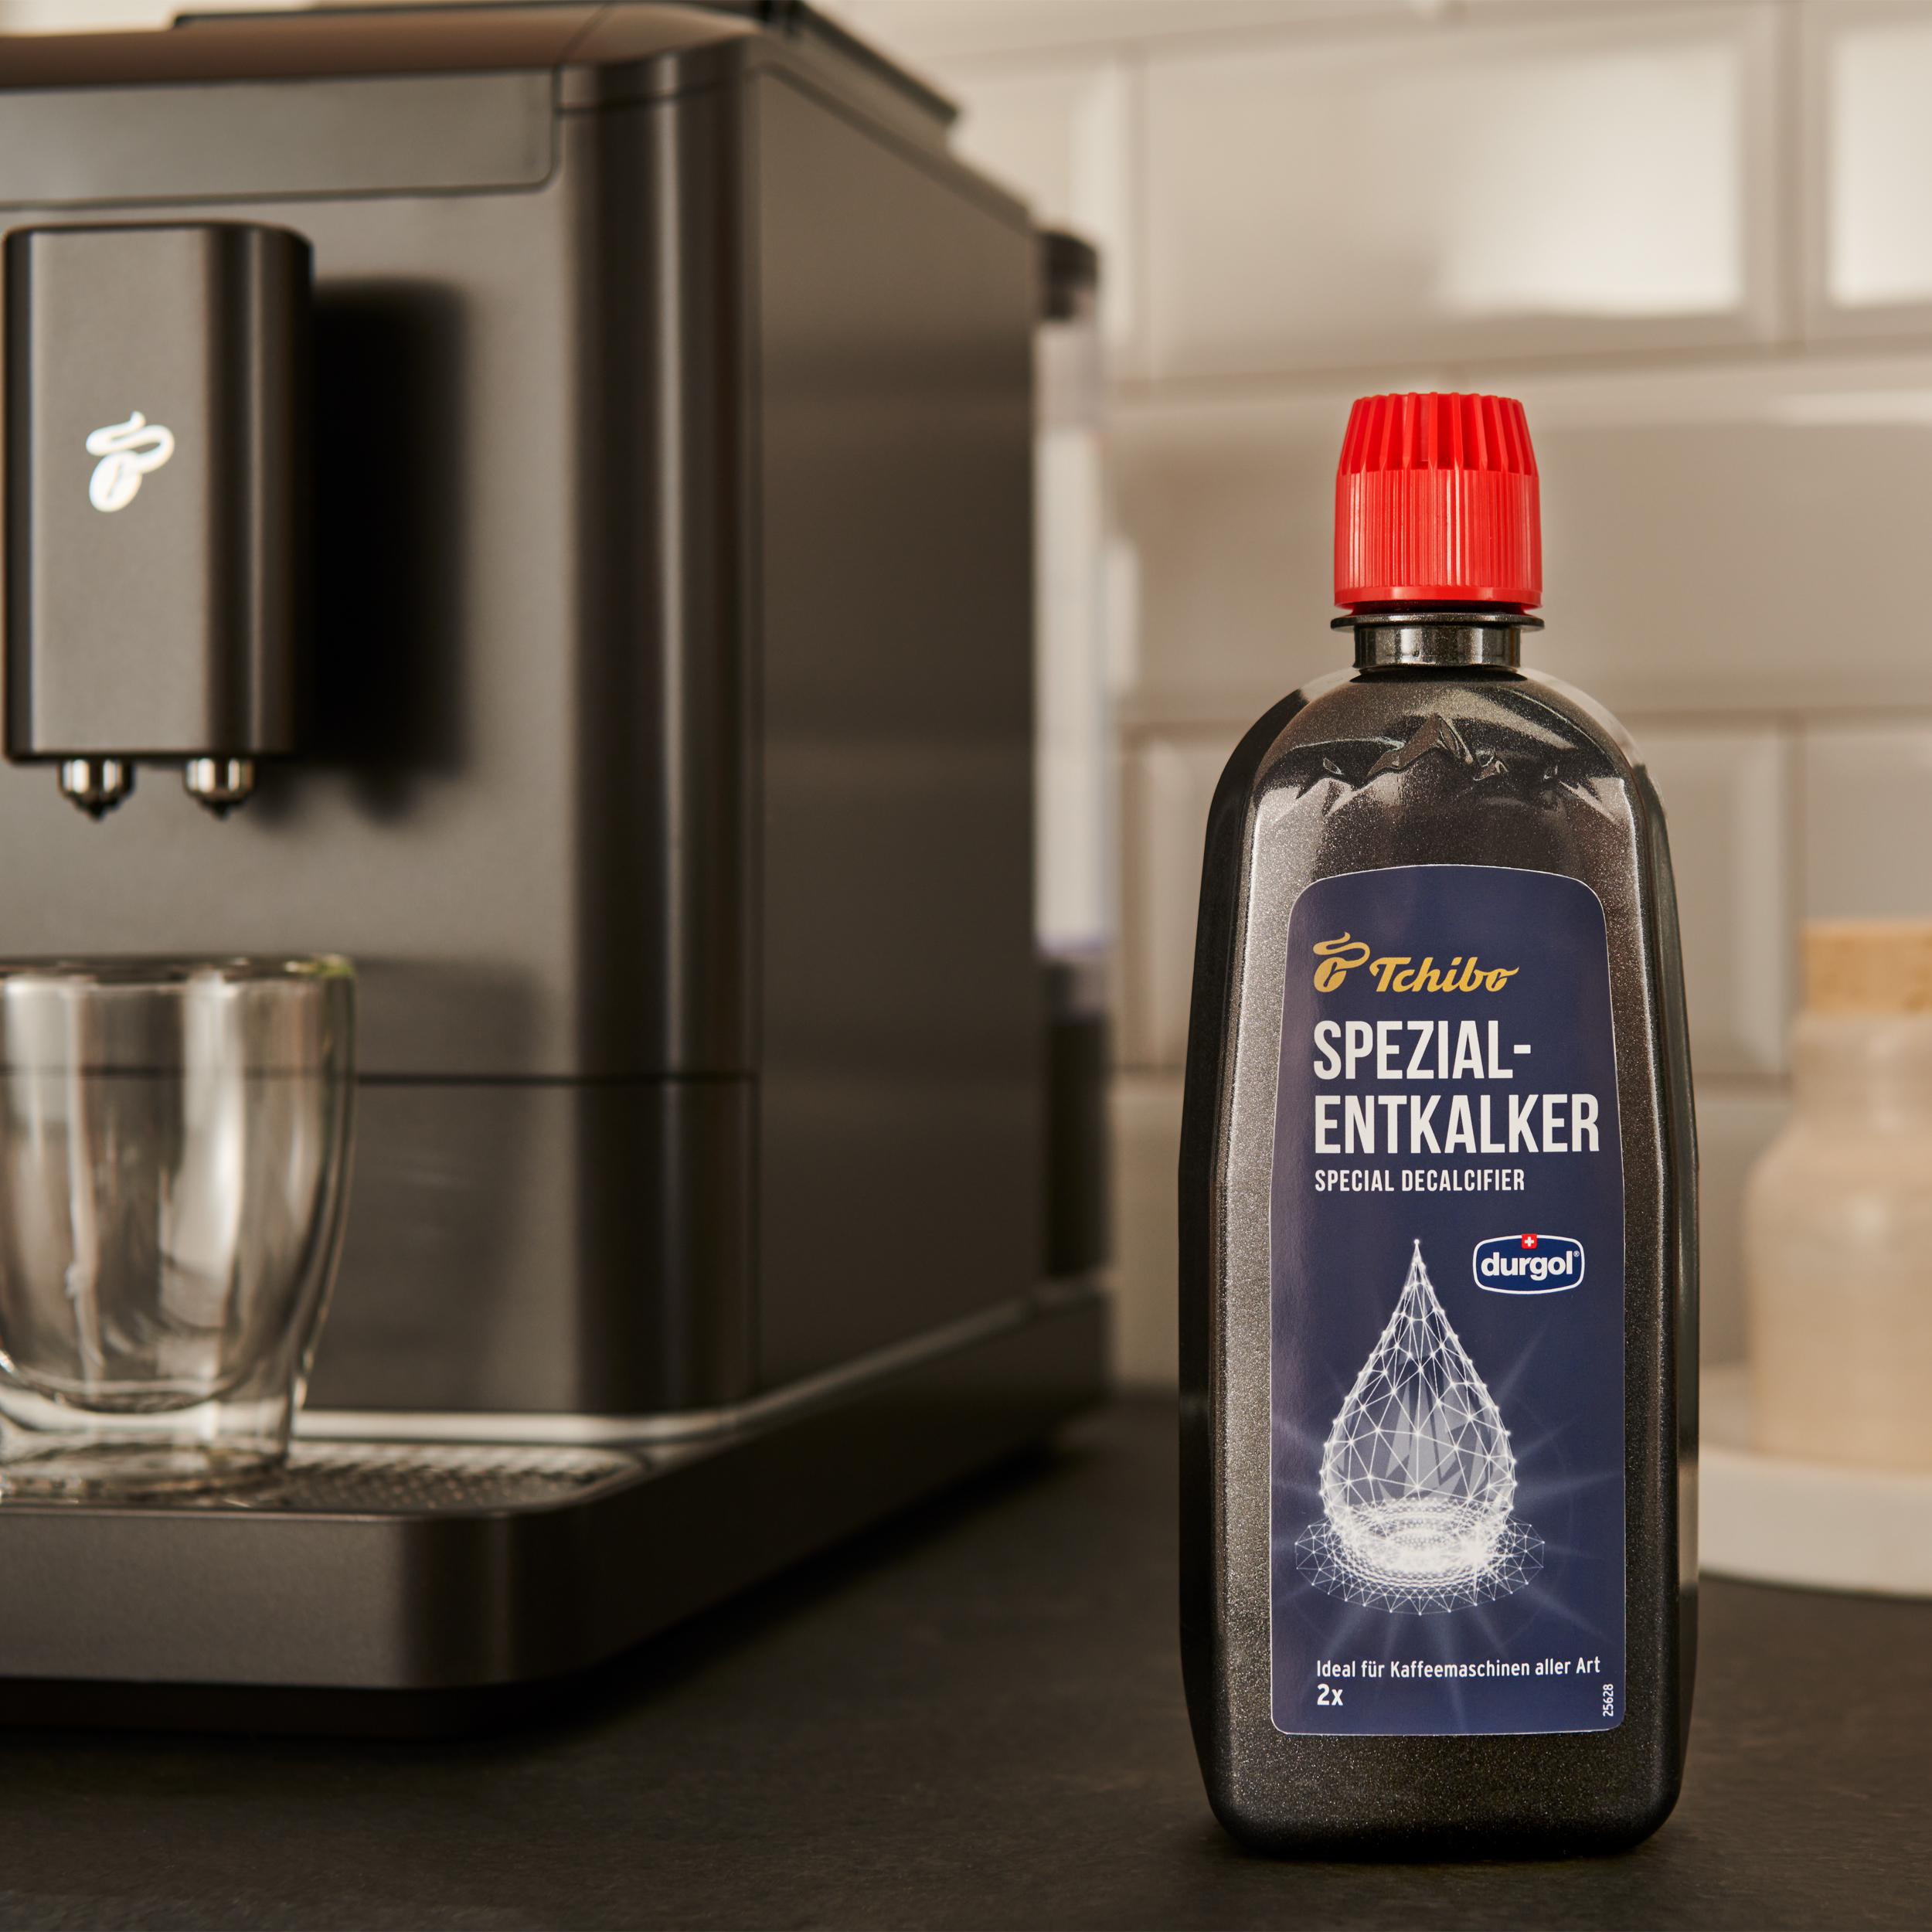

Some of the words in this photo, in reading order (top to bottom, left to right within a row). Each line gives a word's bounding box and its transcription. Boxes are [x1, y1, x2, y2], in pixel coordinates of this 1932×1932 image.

[1369, 956, 1519, 992] Tchibo
[1314, 1020, 1532, 1080] SPEZIAL-
[1315, 1094, 1600, 1154] ENTKALKER
[1315, 1169, 1395, 1192] SPECIAL
[1402, 1168, 1526, 1191] DECALCIFIER
[1317, 1660, 1356, 1678] Ideal
[1361, 1661, 1386, 1678] für
[1391, 1659, 1530, 1678] Kaffeemaschinen
[1535, 1658, 1572, 1675] aller
[1576, 1656, 1601, 1674] Art
[1317, 1684, 1344, 1706] 2x
[1602, 1683, 1614, 1717] 25628
